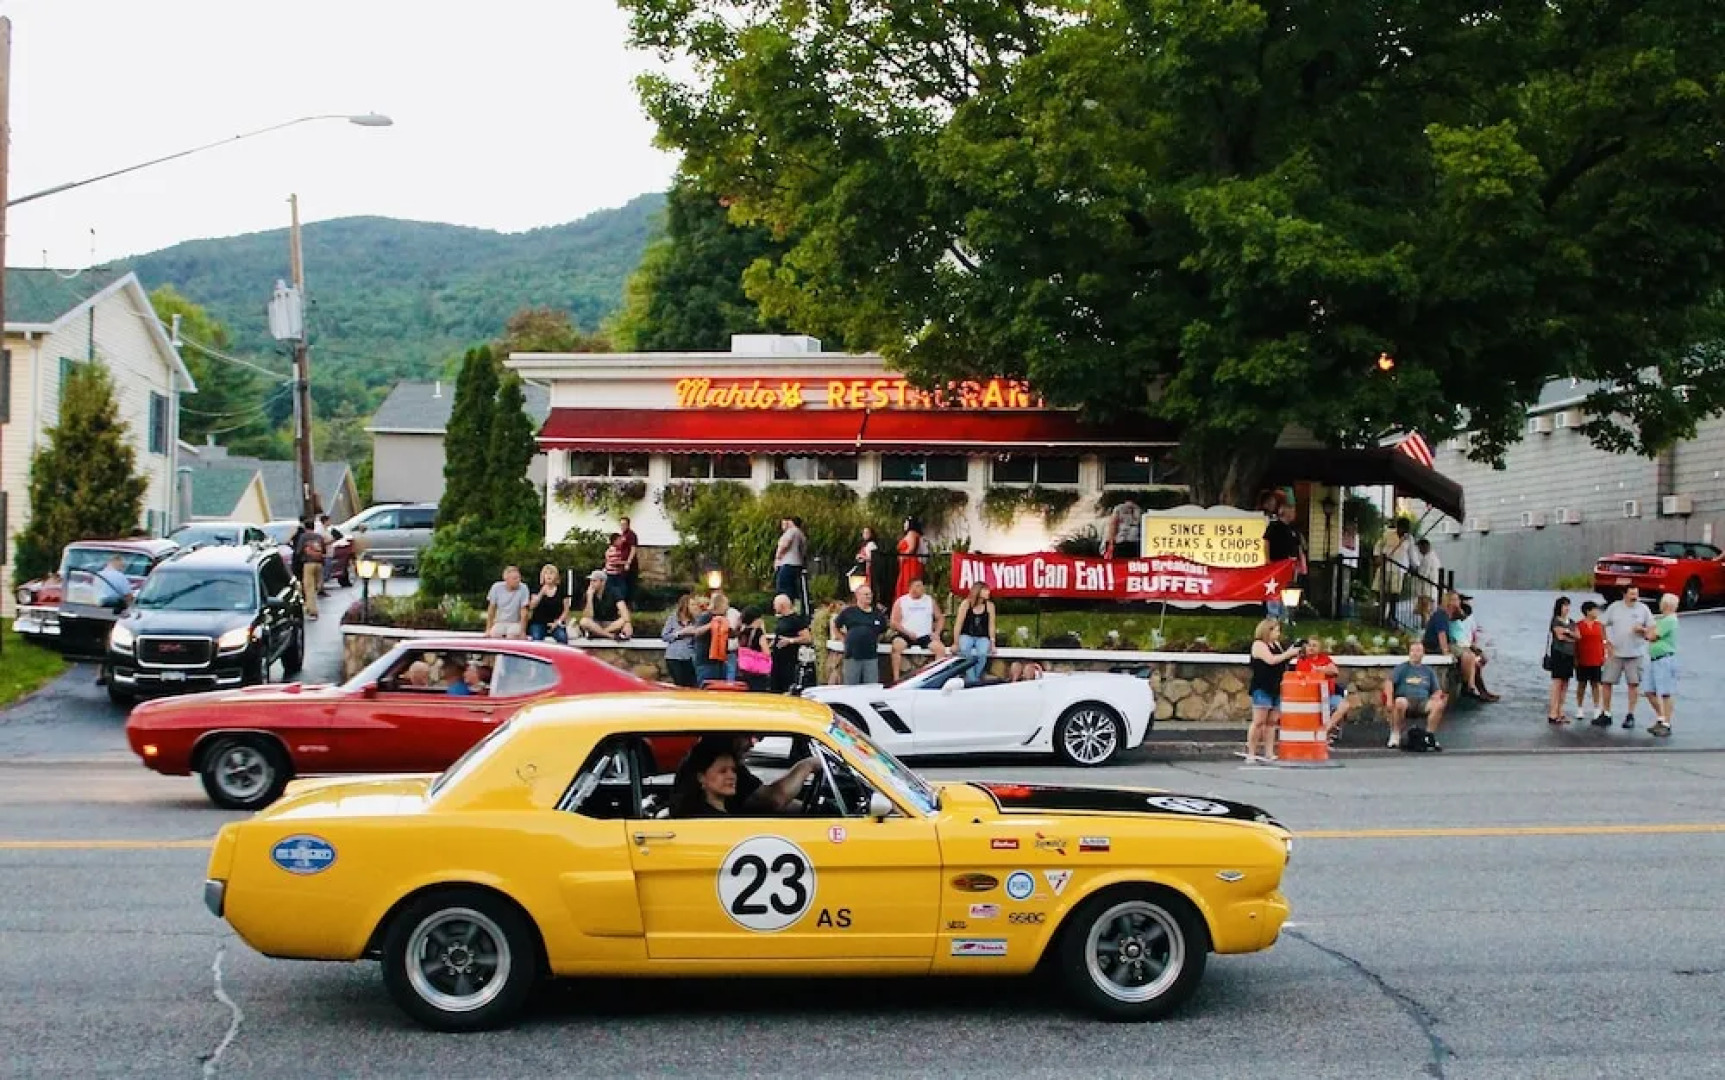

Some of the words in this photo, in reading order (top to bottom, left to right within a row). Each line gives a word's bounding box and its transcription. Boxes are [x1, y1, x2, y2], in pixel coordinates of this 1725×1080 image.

[676, 378, 802, 409] Mario's
[1170, 524, 1205, 536] SINCE
[1214, 524, 1243, 536] 1954
[1153, 537, 1200, 549] STEAKS
[1206, 538, 1213, 549] &
[1220, 538, 1261, 551] CHOPS
[1203, 552, 1259, 563] SEAFOOD
[959, 559, 986, 589] All
[992, 561, 1027, 589] You
[1032, 558, 1068, 589] Can
[1074, 560, 1115, 591] Eat!
[1127, 576, 1213, 595] BUFFET
[832, 828, 843, 841] E
[731, 853, 807, 915] 23
[816, 908, 852, 928] AS
